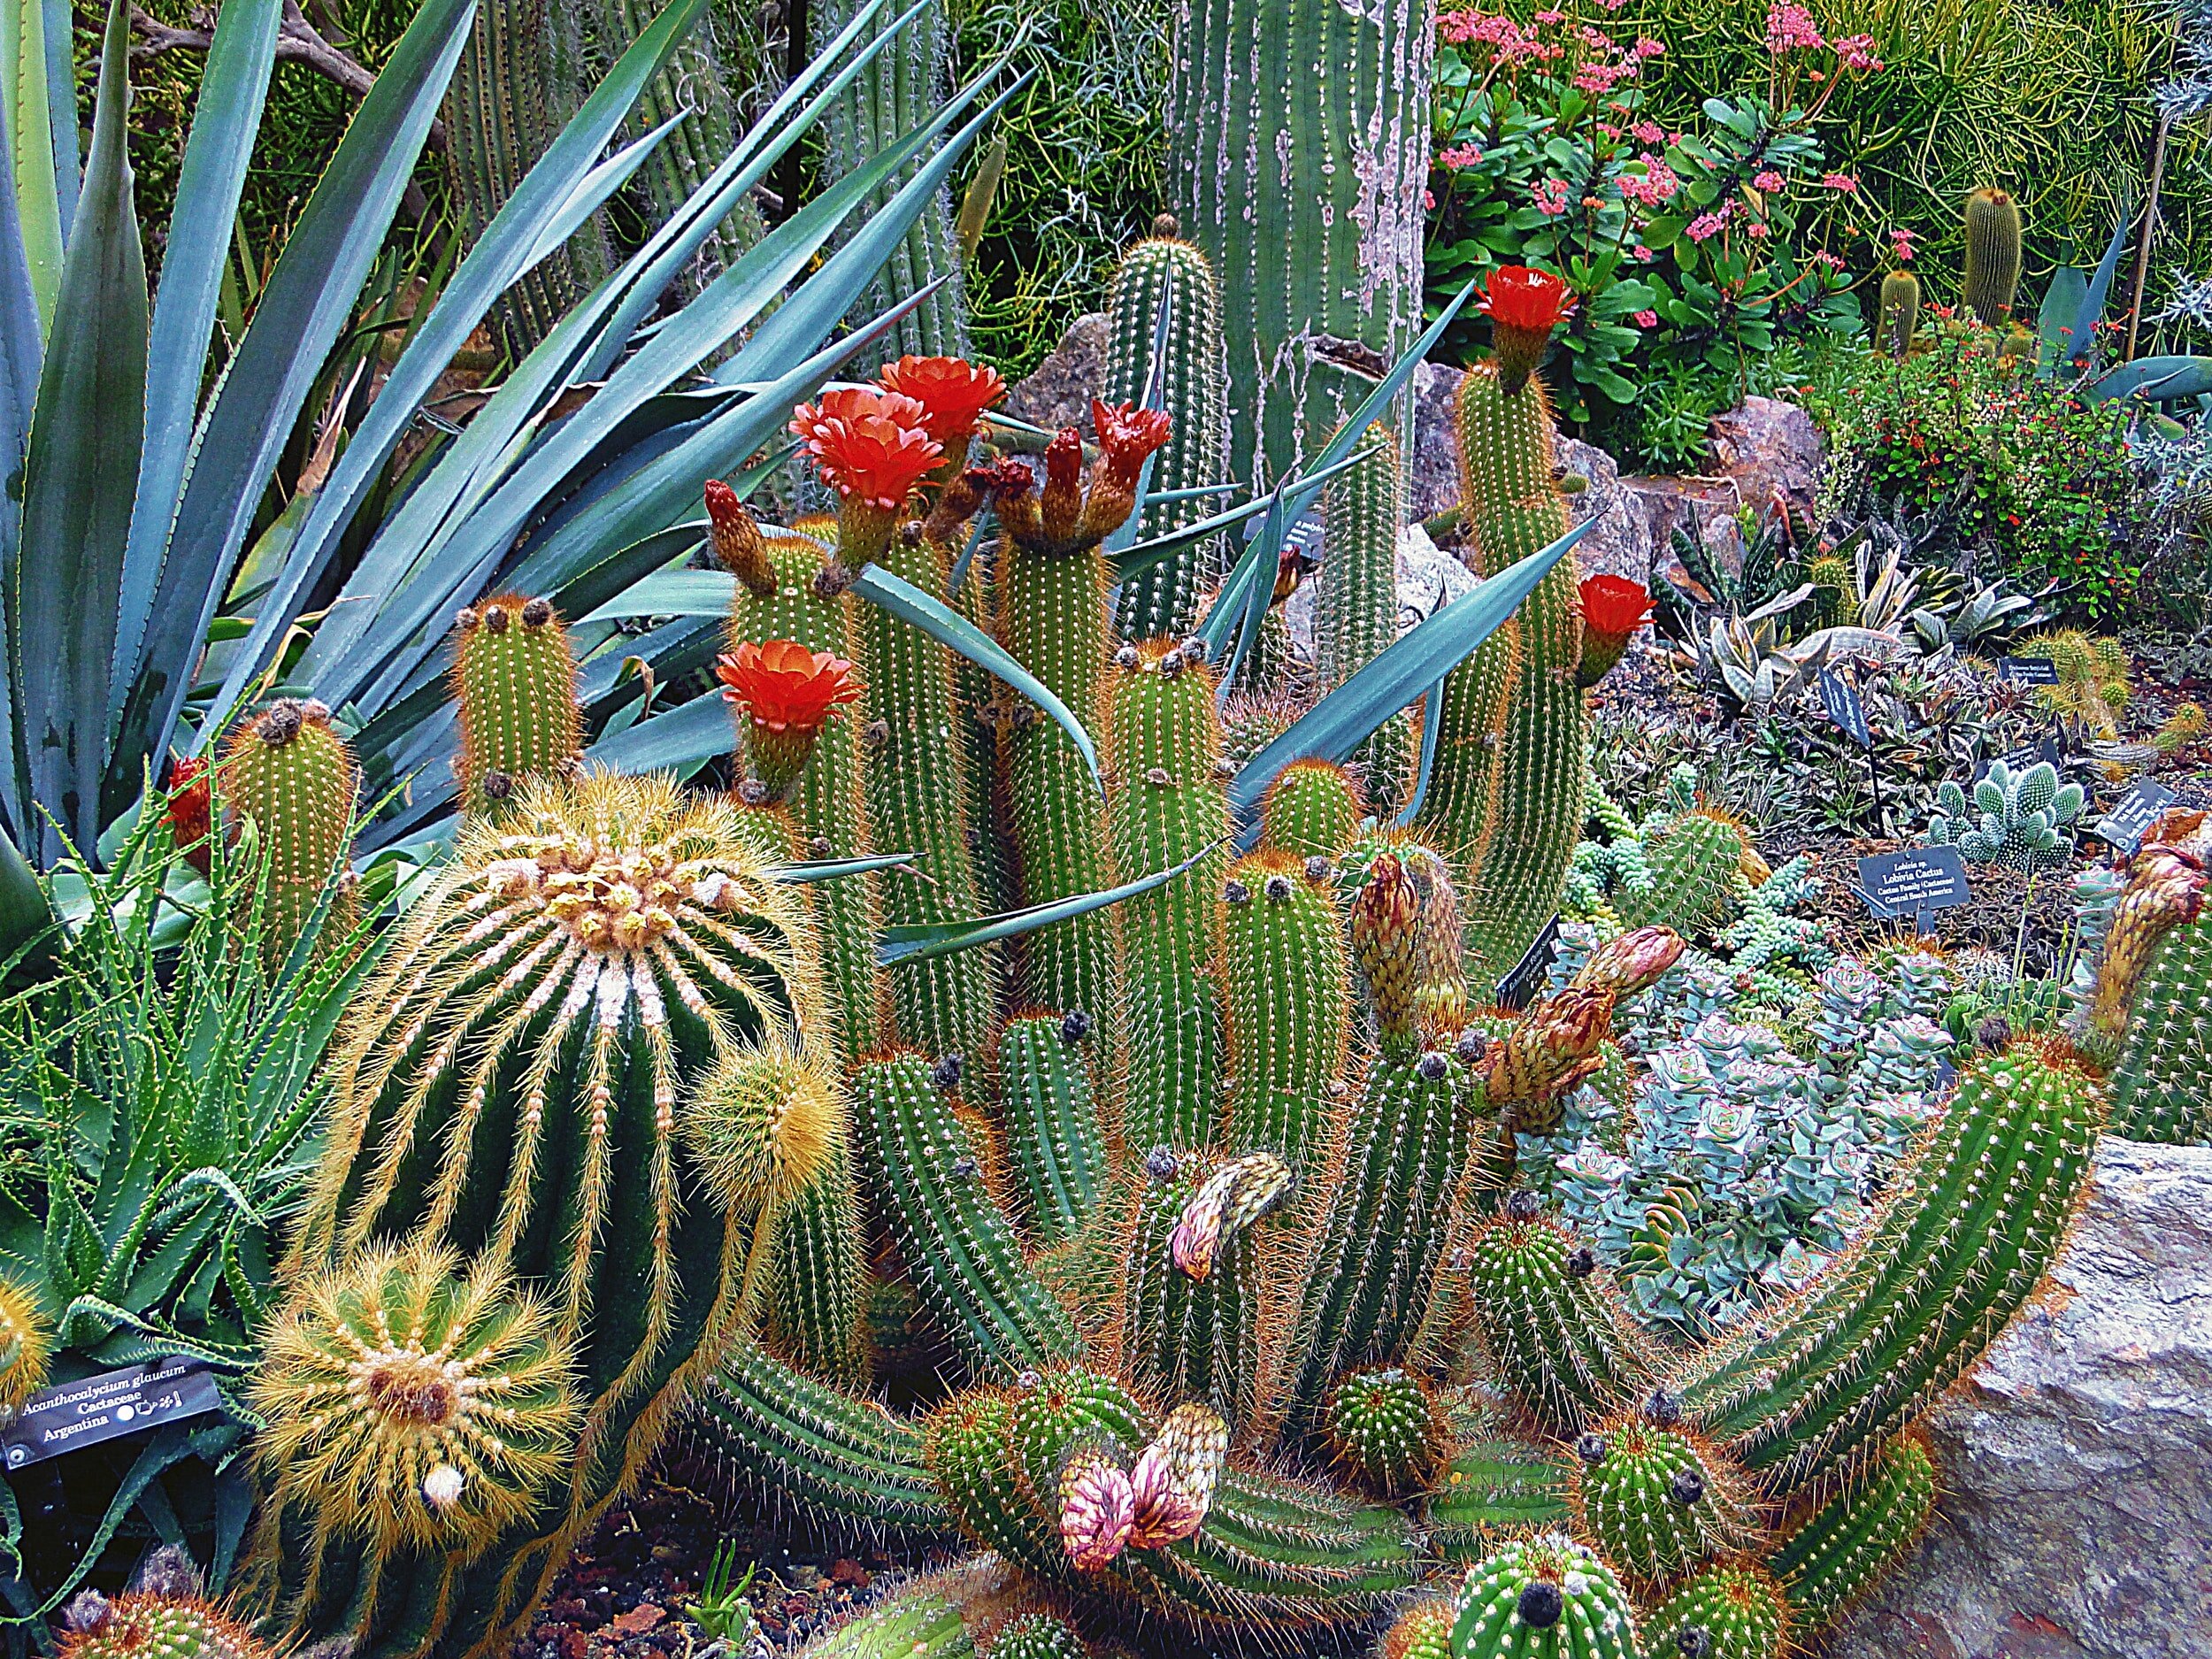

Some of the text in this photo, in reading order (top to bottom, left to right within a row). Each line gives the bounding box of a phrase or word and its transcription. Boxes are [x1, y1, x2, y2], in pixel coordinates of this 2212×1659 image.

[1882, 867, 1944, 885] Lobivia Cactus
[1878, 887, 1900, 895] Cactus
[1900, 882, 1921, 893] Family
[1885, 887, 1954, 904] Central South America
[22, 1364, 186, 1417] Acanthocalycium glaucum
[77, 1391, 142, 1416] Cactaceae
[43, 1415, 109, 1442] Argentina
